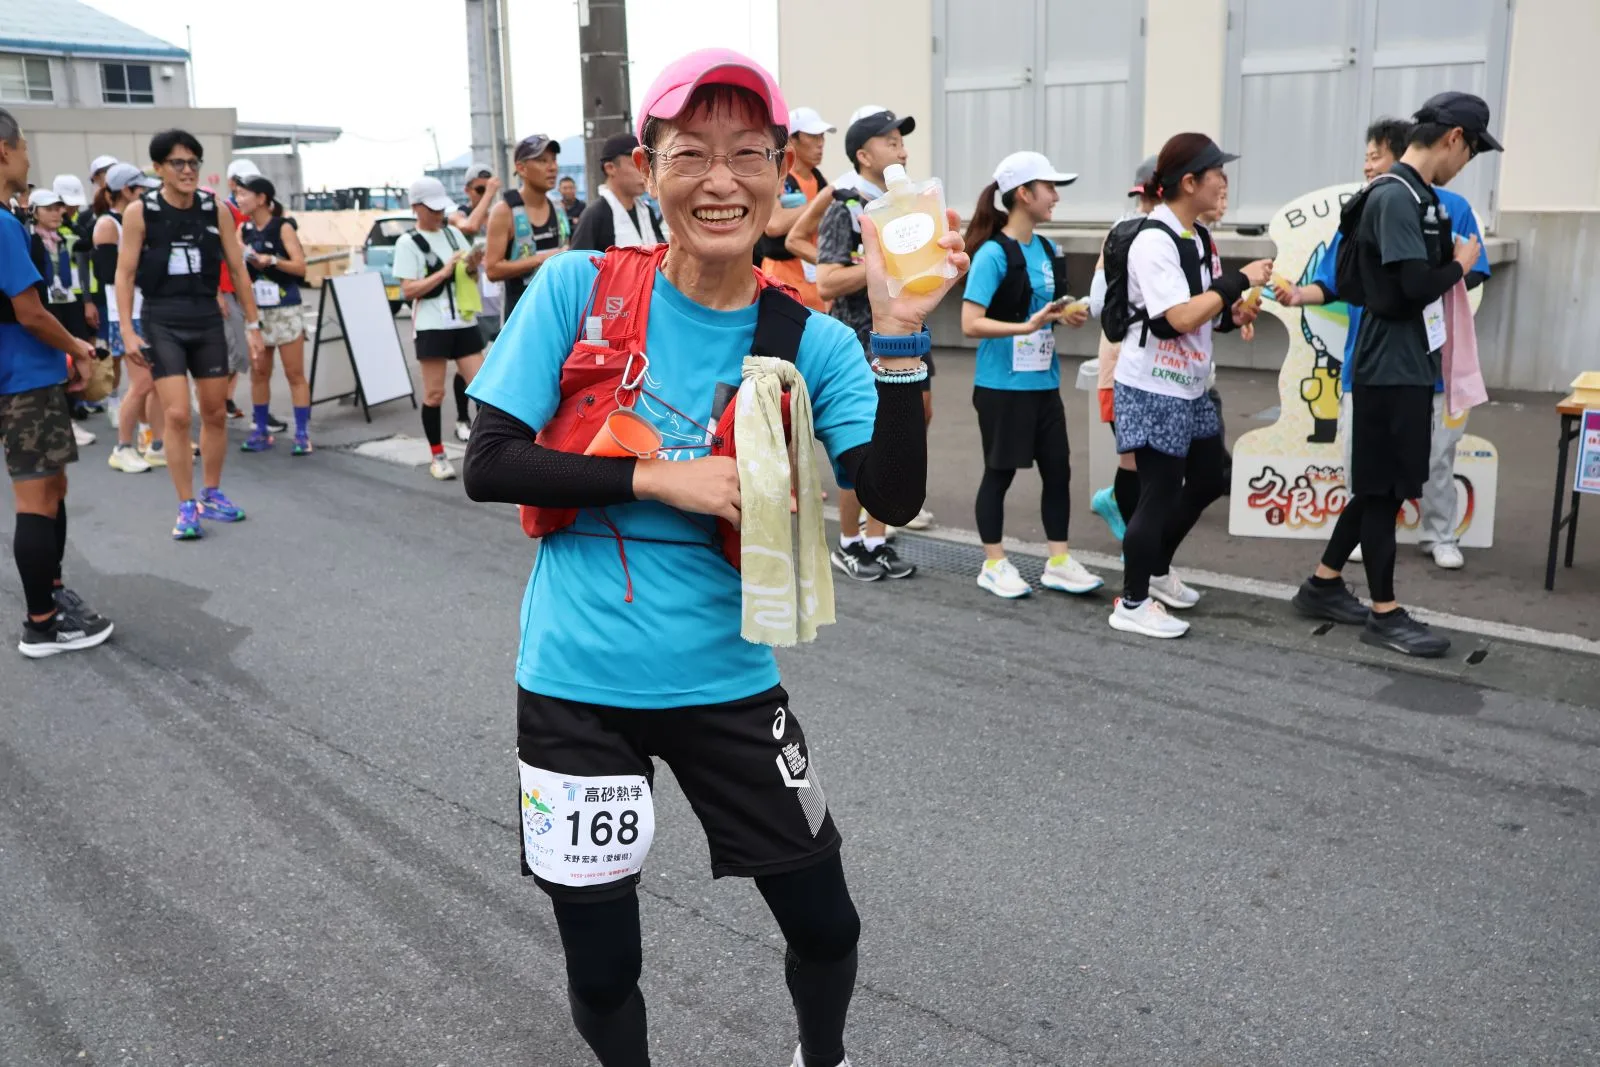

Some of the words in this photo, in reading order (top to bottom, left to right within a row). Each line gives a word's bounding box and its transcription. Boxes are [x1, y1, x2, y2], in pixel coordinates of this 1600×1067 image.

[1151, 367, 1191, 386] EXPRESS
[584, 785, 643, 803] 高砂熱学
[566, 809, 639, 847] 168
